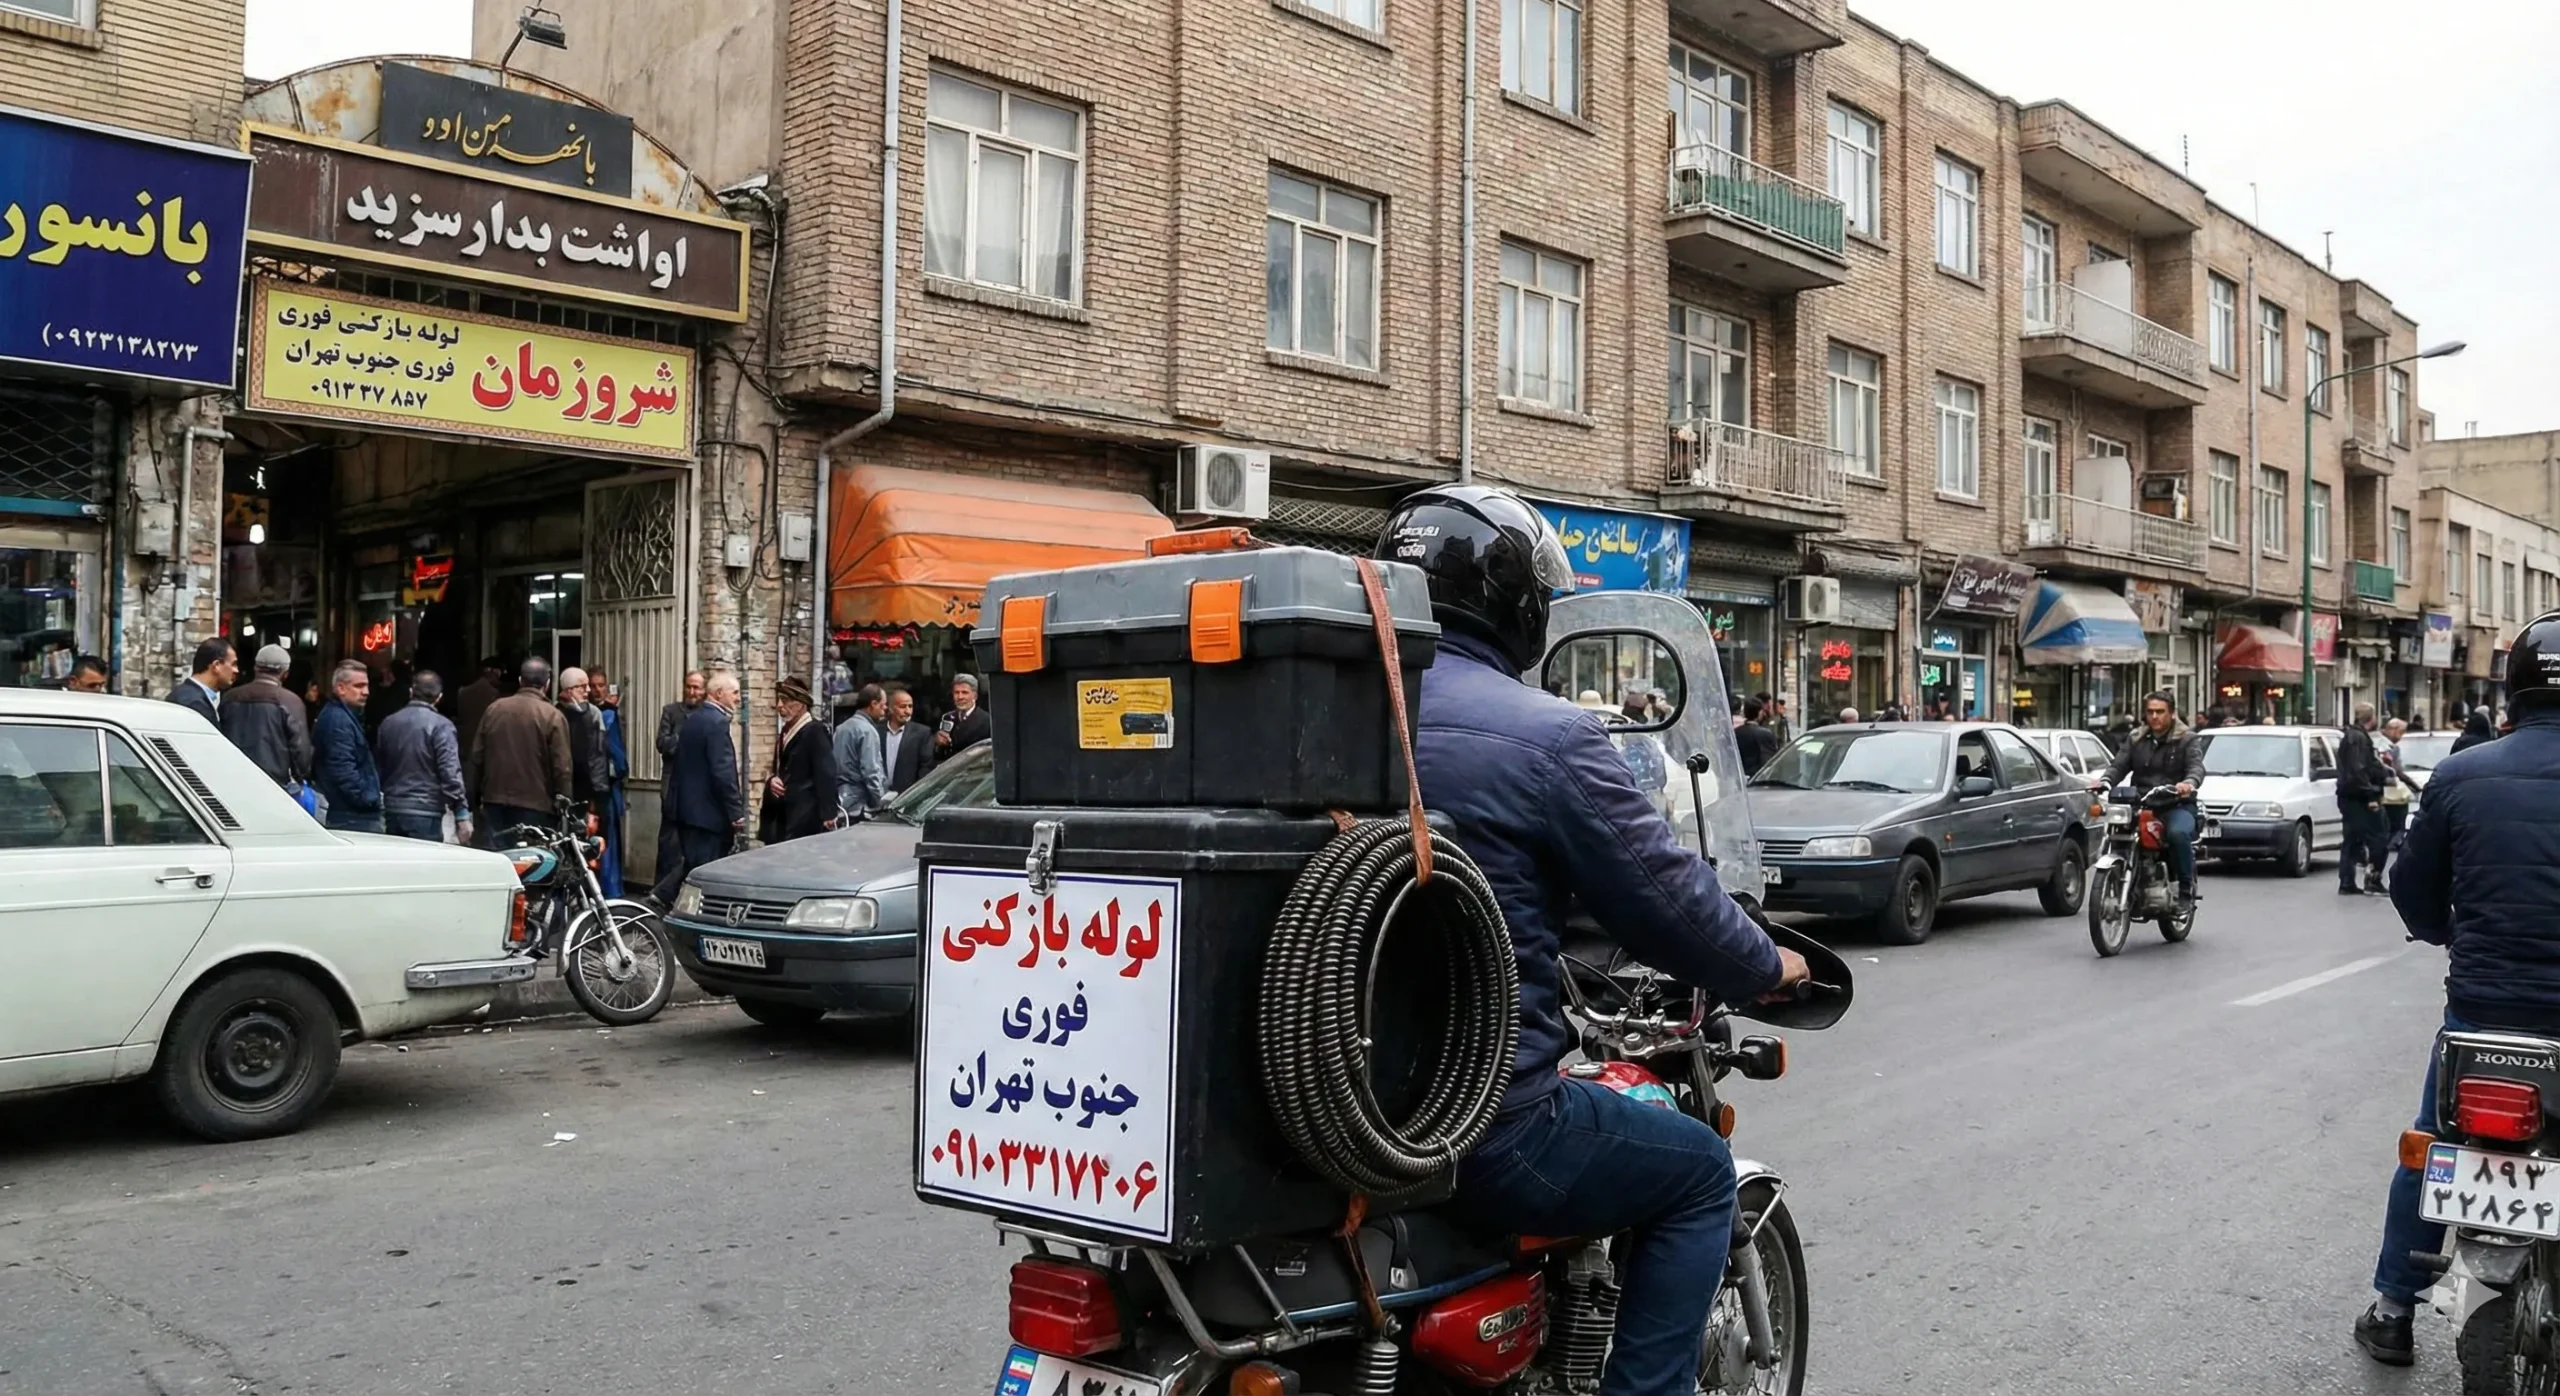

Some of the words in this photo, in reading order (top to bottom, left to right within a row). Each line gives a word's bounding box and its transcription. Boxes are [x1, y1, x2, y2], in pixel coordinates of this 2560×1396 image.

[278, 303, 332, 330] فوری
[416, 322, 460, 350] لوله
[285, 338, 340, 366] تهران
[345, 350, 400, 375] جنوب
[405, 356, 455, 383] فوری
[1080, 896, 1163, 978] لوله
[1002, 980, 1089, 1047] فوری
[2474, 1052, 2557, 1071] HONDA
[950, 1050, 1035, 1114] تهران
[1043, 1072, 1140, 1133] جنوب
